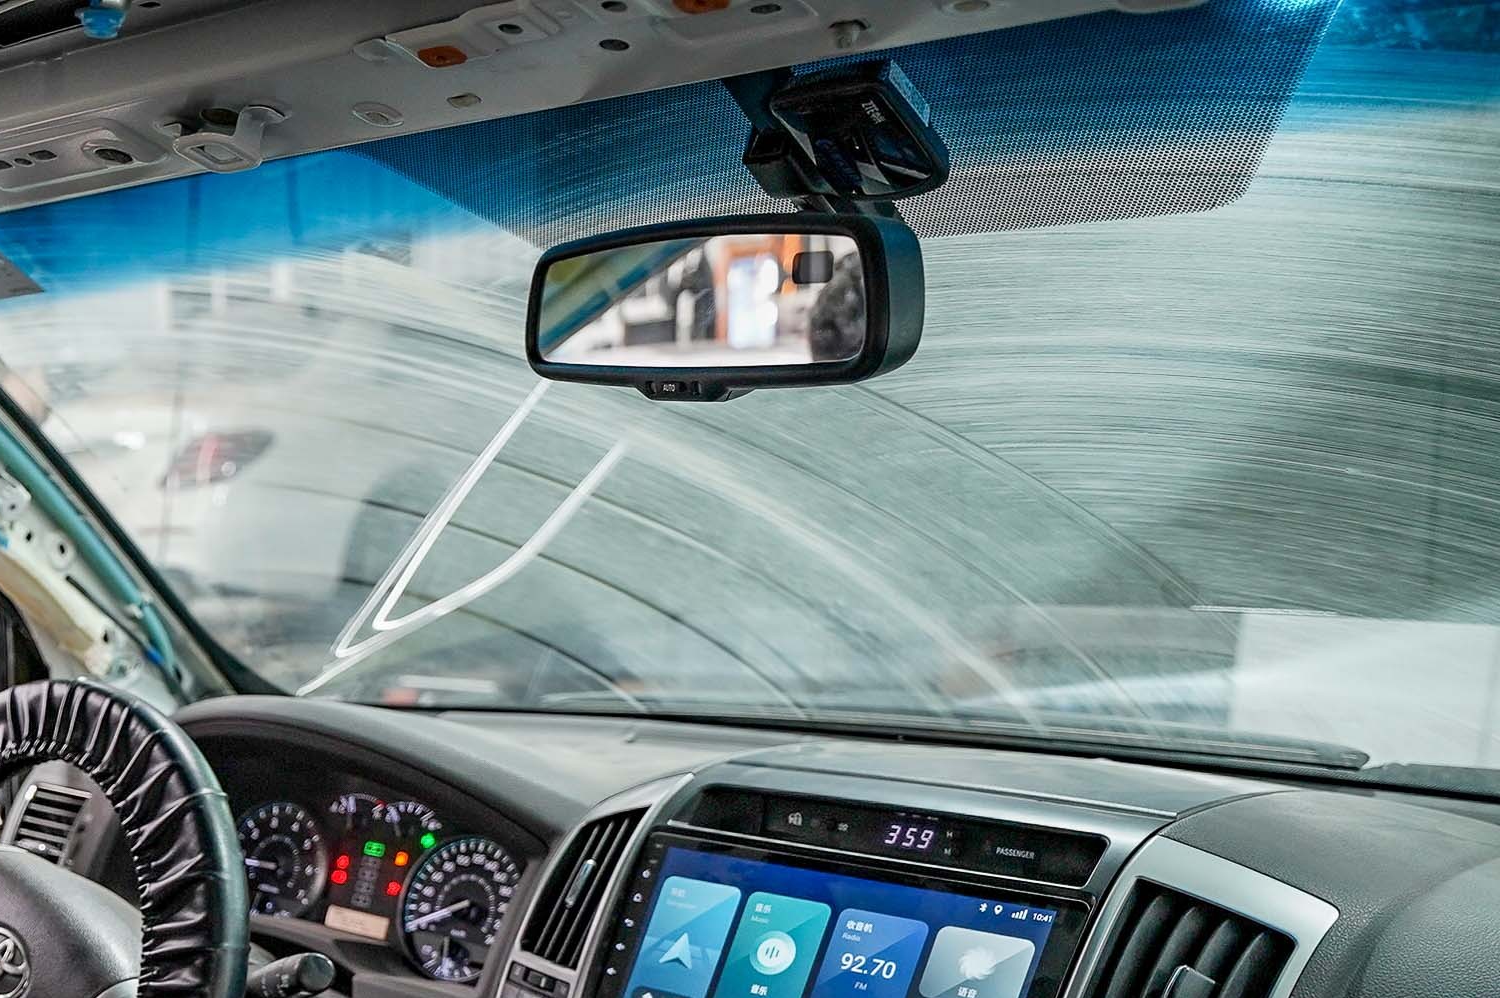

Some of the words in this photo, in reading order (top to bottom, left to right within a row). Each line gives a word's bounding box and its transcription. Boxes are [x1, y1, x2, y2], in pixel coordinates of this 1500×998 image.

[884, 824, 935, 849] 359
[995, 846, 1036, 860] PASSENGER
[1032, 912, 1053, 923] 10:41
[845, 919, 874, 934] 收音机
[840, 952, 897, 980] 92.70
[750, 983, 769, 996] 音乐
[854, 981, 867, 991] FM
[957, 986, 978, 998] 语音
